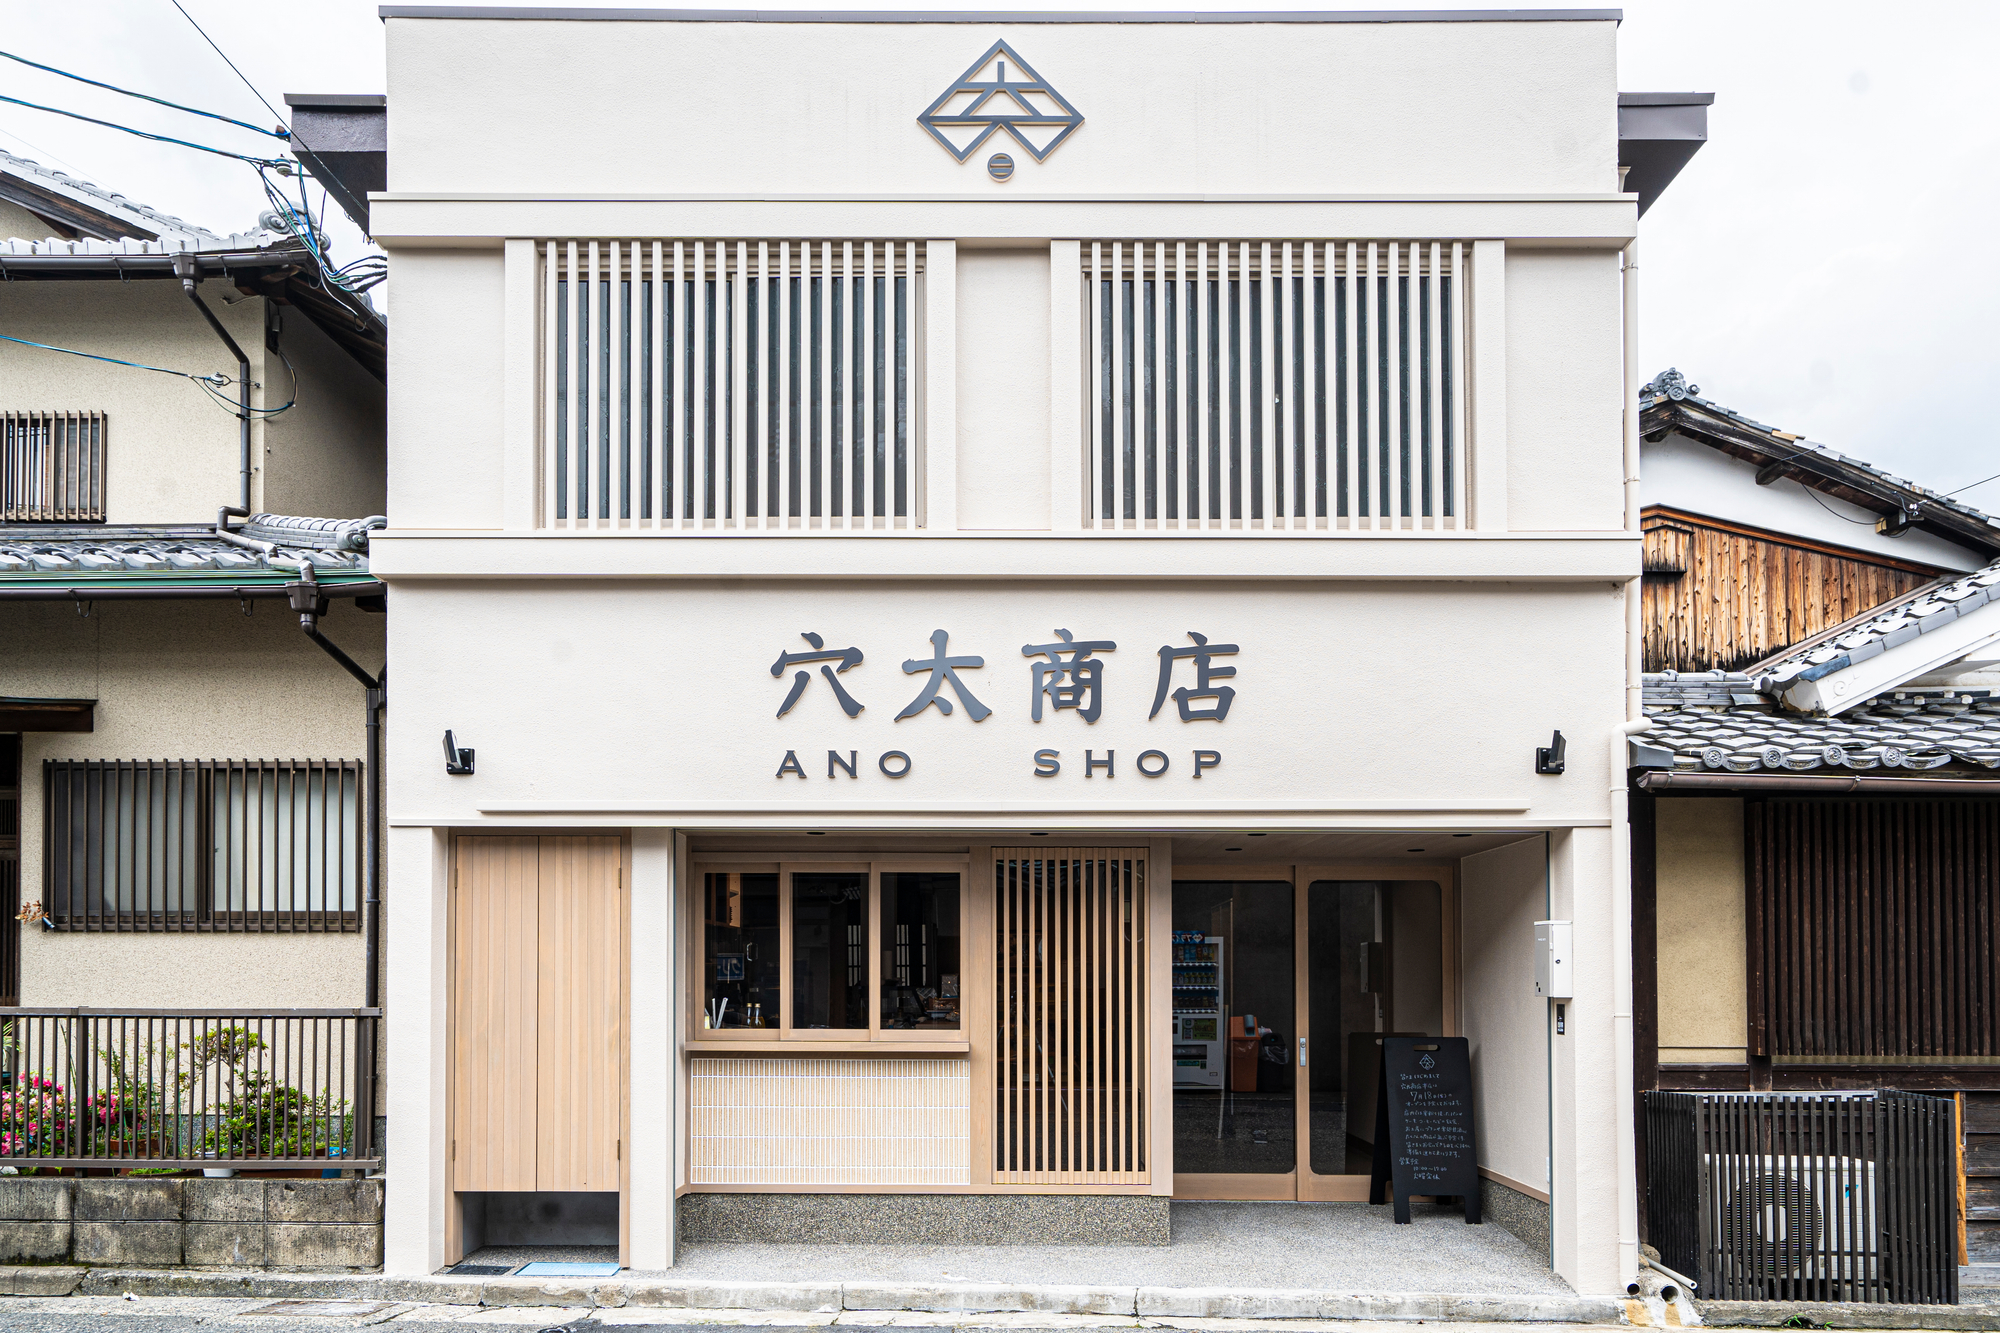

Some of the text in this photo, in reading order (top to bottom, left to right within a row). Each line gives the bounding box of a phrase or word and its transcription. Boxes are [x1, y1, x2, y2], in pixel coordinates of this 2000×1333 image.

[770, 629, 1239, 724] 穴太商店
[775, 749, 1222, 778] ANO SHOP
